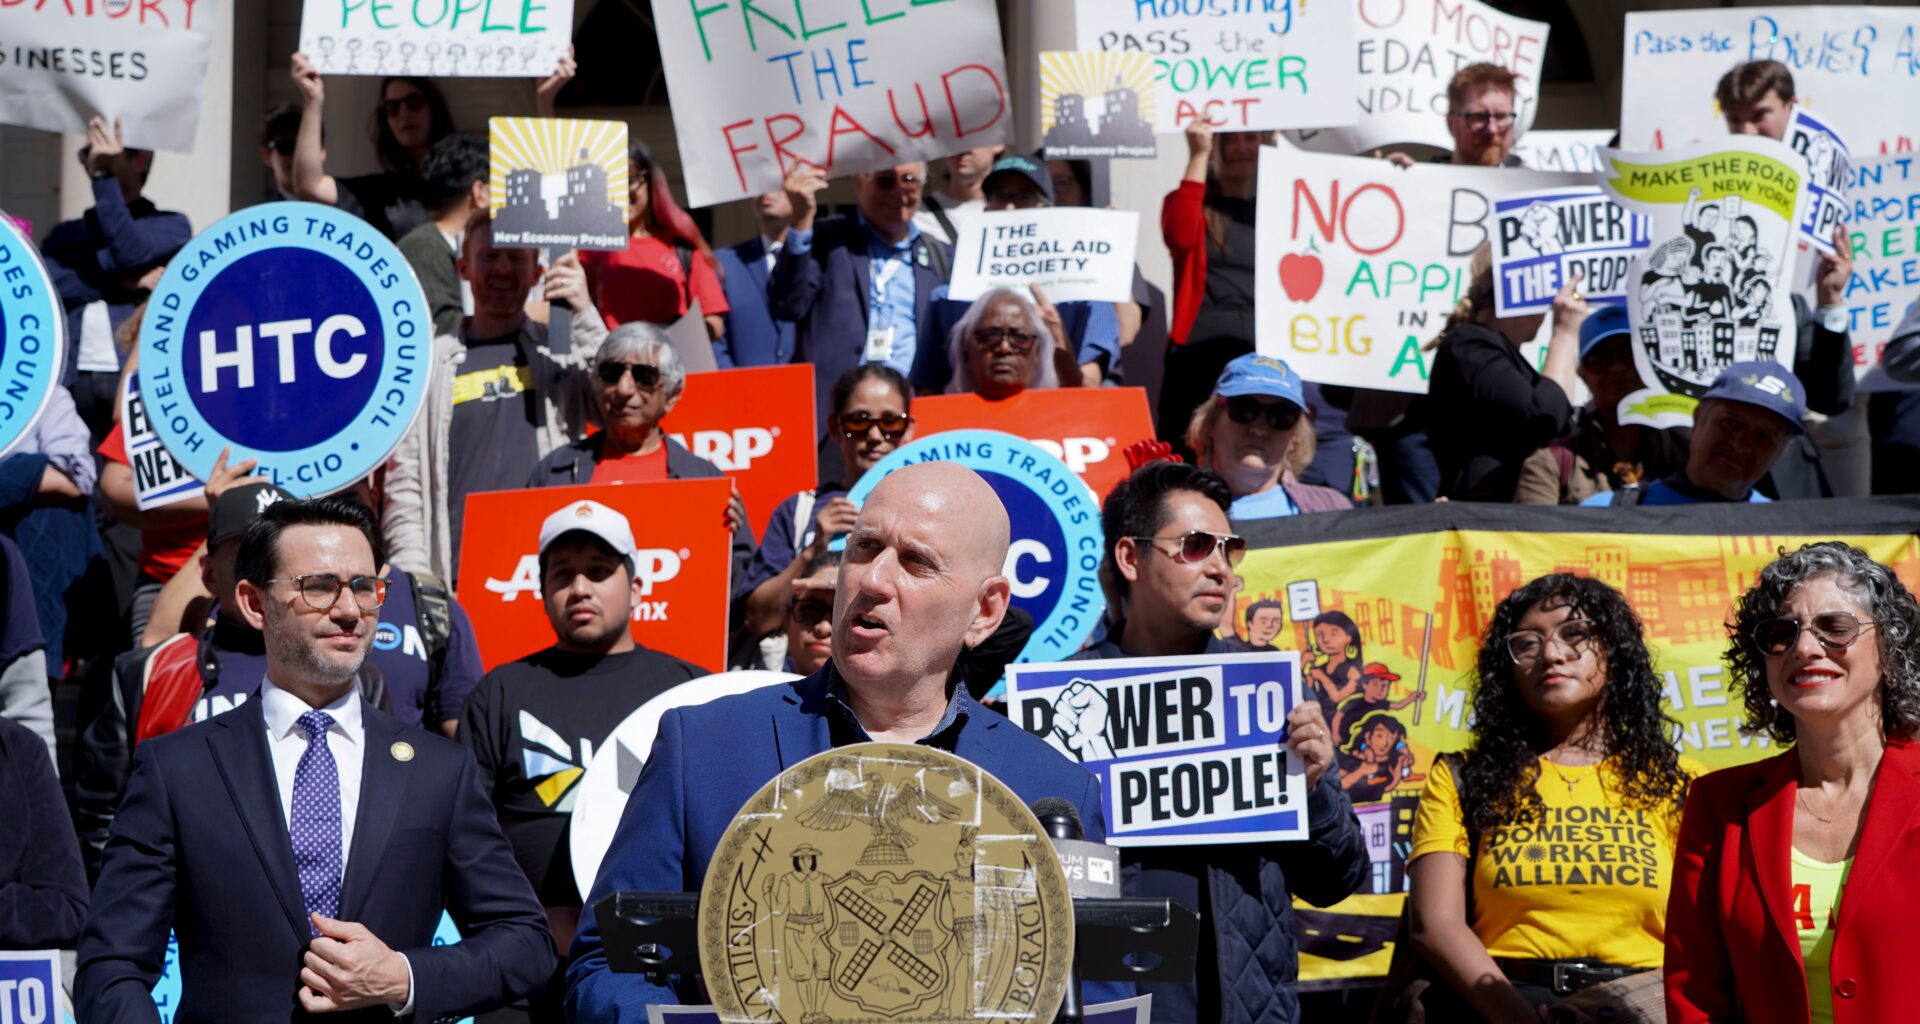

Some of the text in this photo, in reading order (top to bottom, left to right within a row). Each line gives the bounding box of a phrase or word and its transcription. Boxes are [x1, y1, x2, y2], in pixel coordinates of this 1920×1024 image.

[342, 0, 547, 34] PEOPLE
[1099, 29, 1264, 54] PASS the
[766, 39, 875, 104] THE
[722, 64, 1005, 192] FRAUD
[1175, 98, 1261, 127] ACT
[1046, 146, 1156, 158] New Economy Project
[1630, 158, 1797, 195] MAKE THE ROAD
[1712, 179, 1792, 211] NEW YORK
[995, 223, 1038, 240] THE
[1291, 178, 1405, 256] NO
[494, 231, 626, 247] New Economy Project
[992, 239, 1111, 259] LEGAL AID
[989, 257, 1089, 276] SOCIETY
[1505, 260, 1558, 305] THE
[181, 216, 417, 429] GAMING TRADES COUNCIL
[1289, 313, 1374, 356] BIG
[1398, 310, 1427, 328] IN
[152, 292, 204, 453] HOTEL AND
[199, 314, 369, 394] HTC
[1007, 448, 1090, 526] TRADES
[1043, 535, 1098, 649] COUNCIL
[1230, 680, 1286, 736] TO
[1119, 751, 1290, 827] PEOPLE!
[1491, 824, 1657, 849] DOMESTIC
[1492, 864, 1660, 890] ALLIANCE
